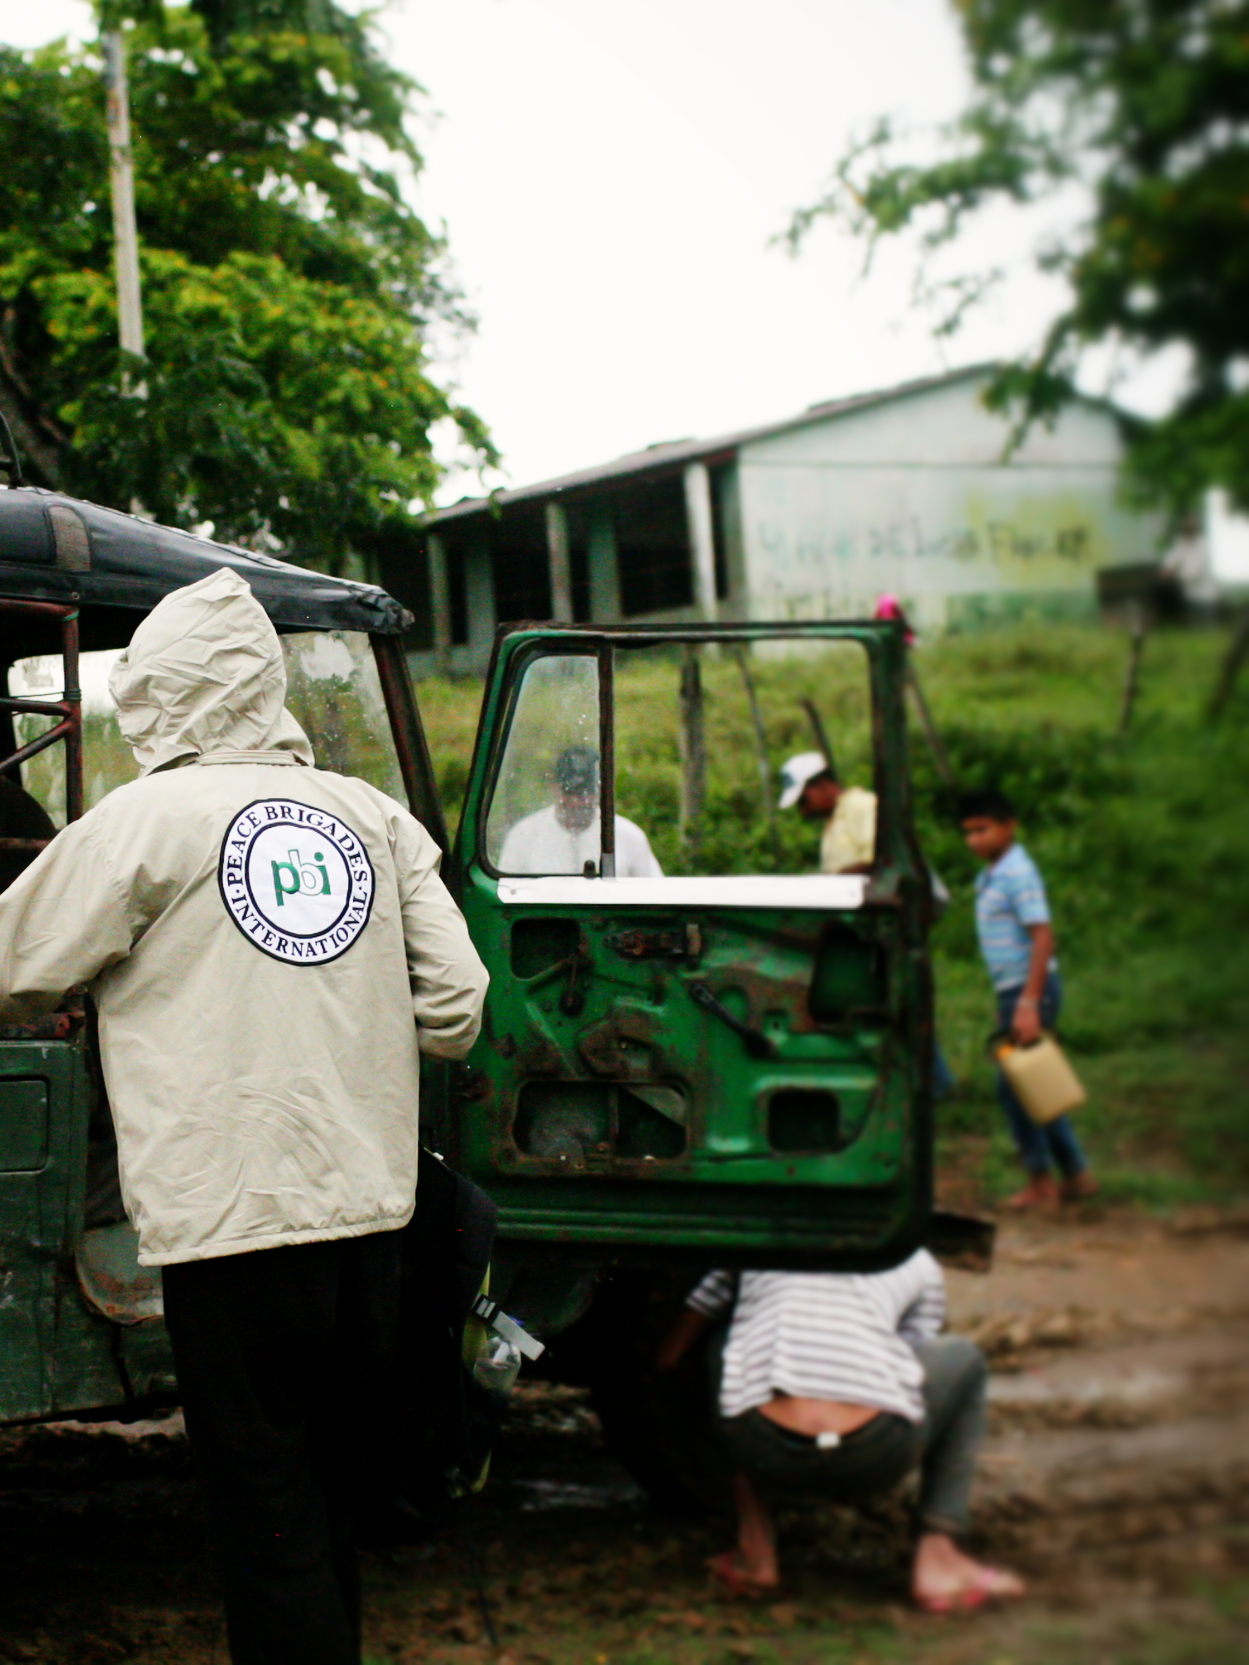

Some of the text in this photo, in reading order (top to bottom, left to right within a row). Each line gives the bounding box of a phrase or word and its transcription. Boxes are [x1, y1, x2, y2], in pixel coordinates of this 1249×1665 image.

[227, 805, 368, 887] PEACE BRIGADES
[270, 848, 332, 907] pbi
[231, 890, 368, 958] INTERNATIONAL
